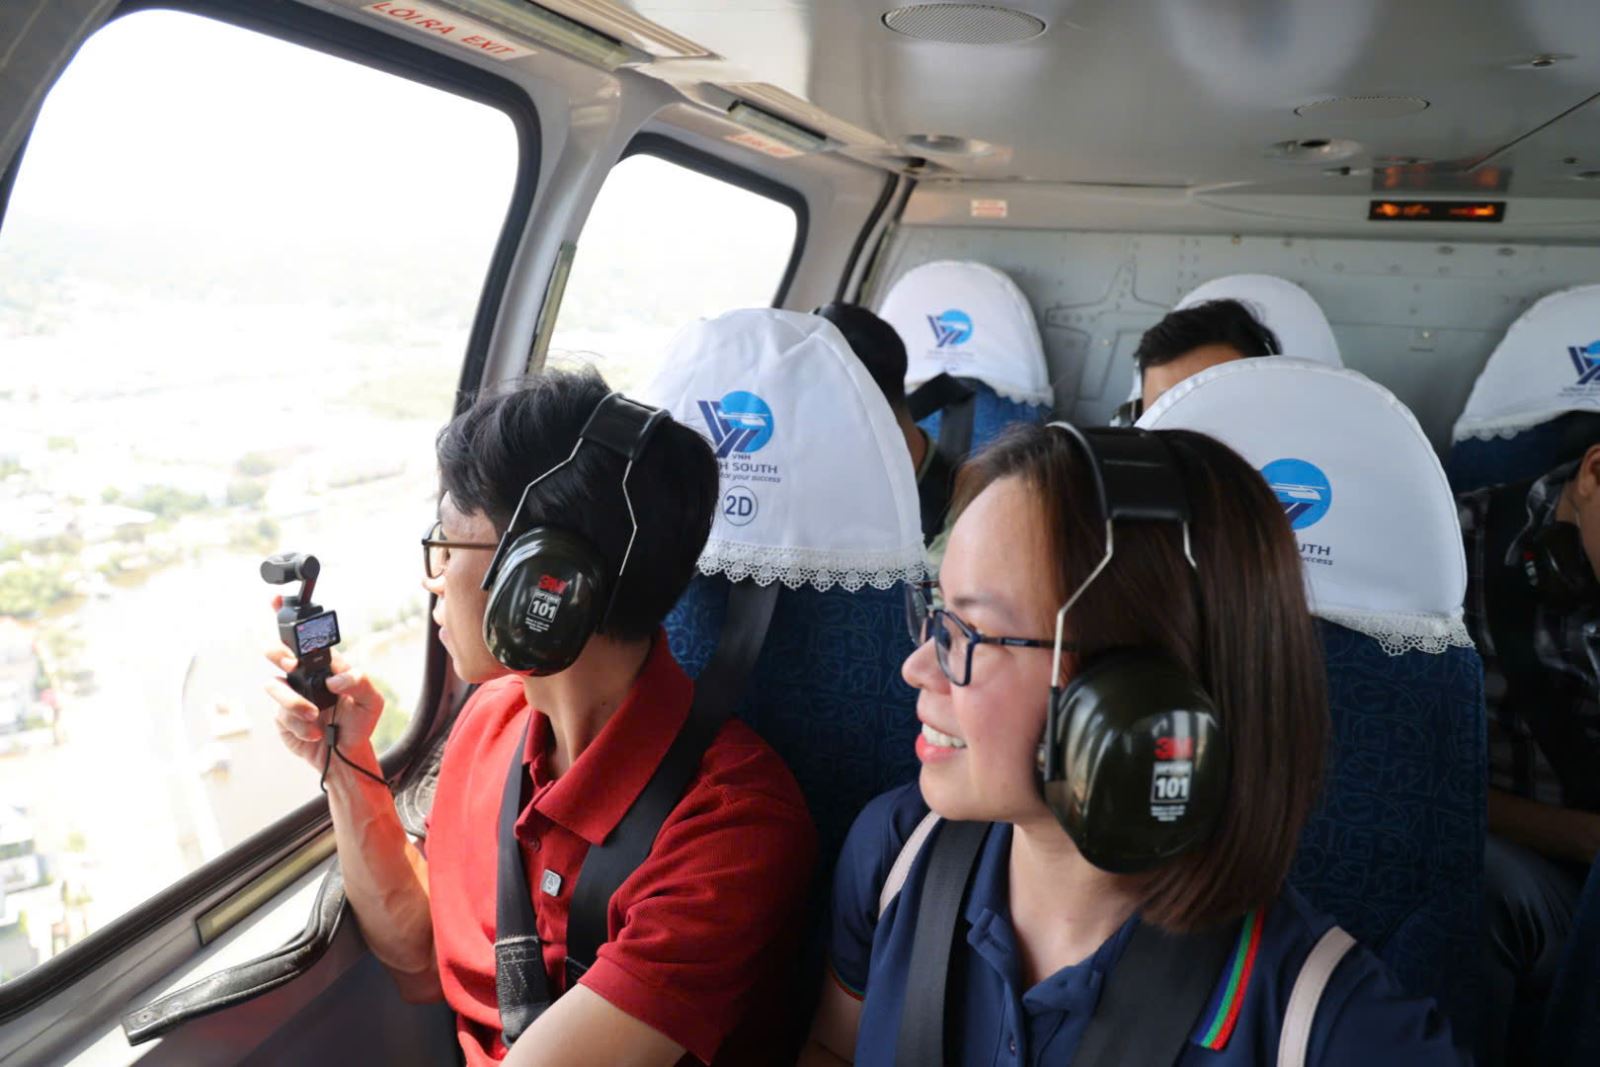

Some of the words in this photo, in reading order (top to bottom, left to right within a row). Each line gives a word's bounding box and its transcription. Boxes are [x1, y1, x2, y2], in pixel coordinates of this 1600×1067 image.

[461, 34, 516, 54] EXIT
[732, 462, 778, 474] SOUTH
[751, 475, 781, 483] success
[725, 495, 753, 517] 2D
[1299, 543, 1331, 556] UTH
[531, 600, 557, 620] 101
[1156, 777, 1188, 798] 101
